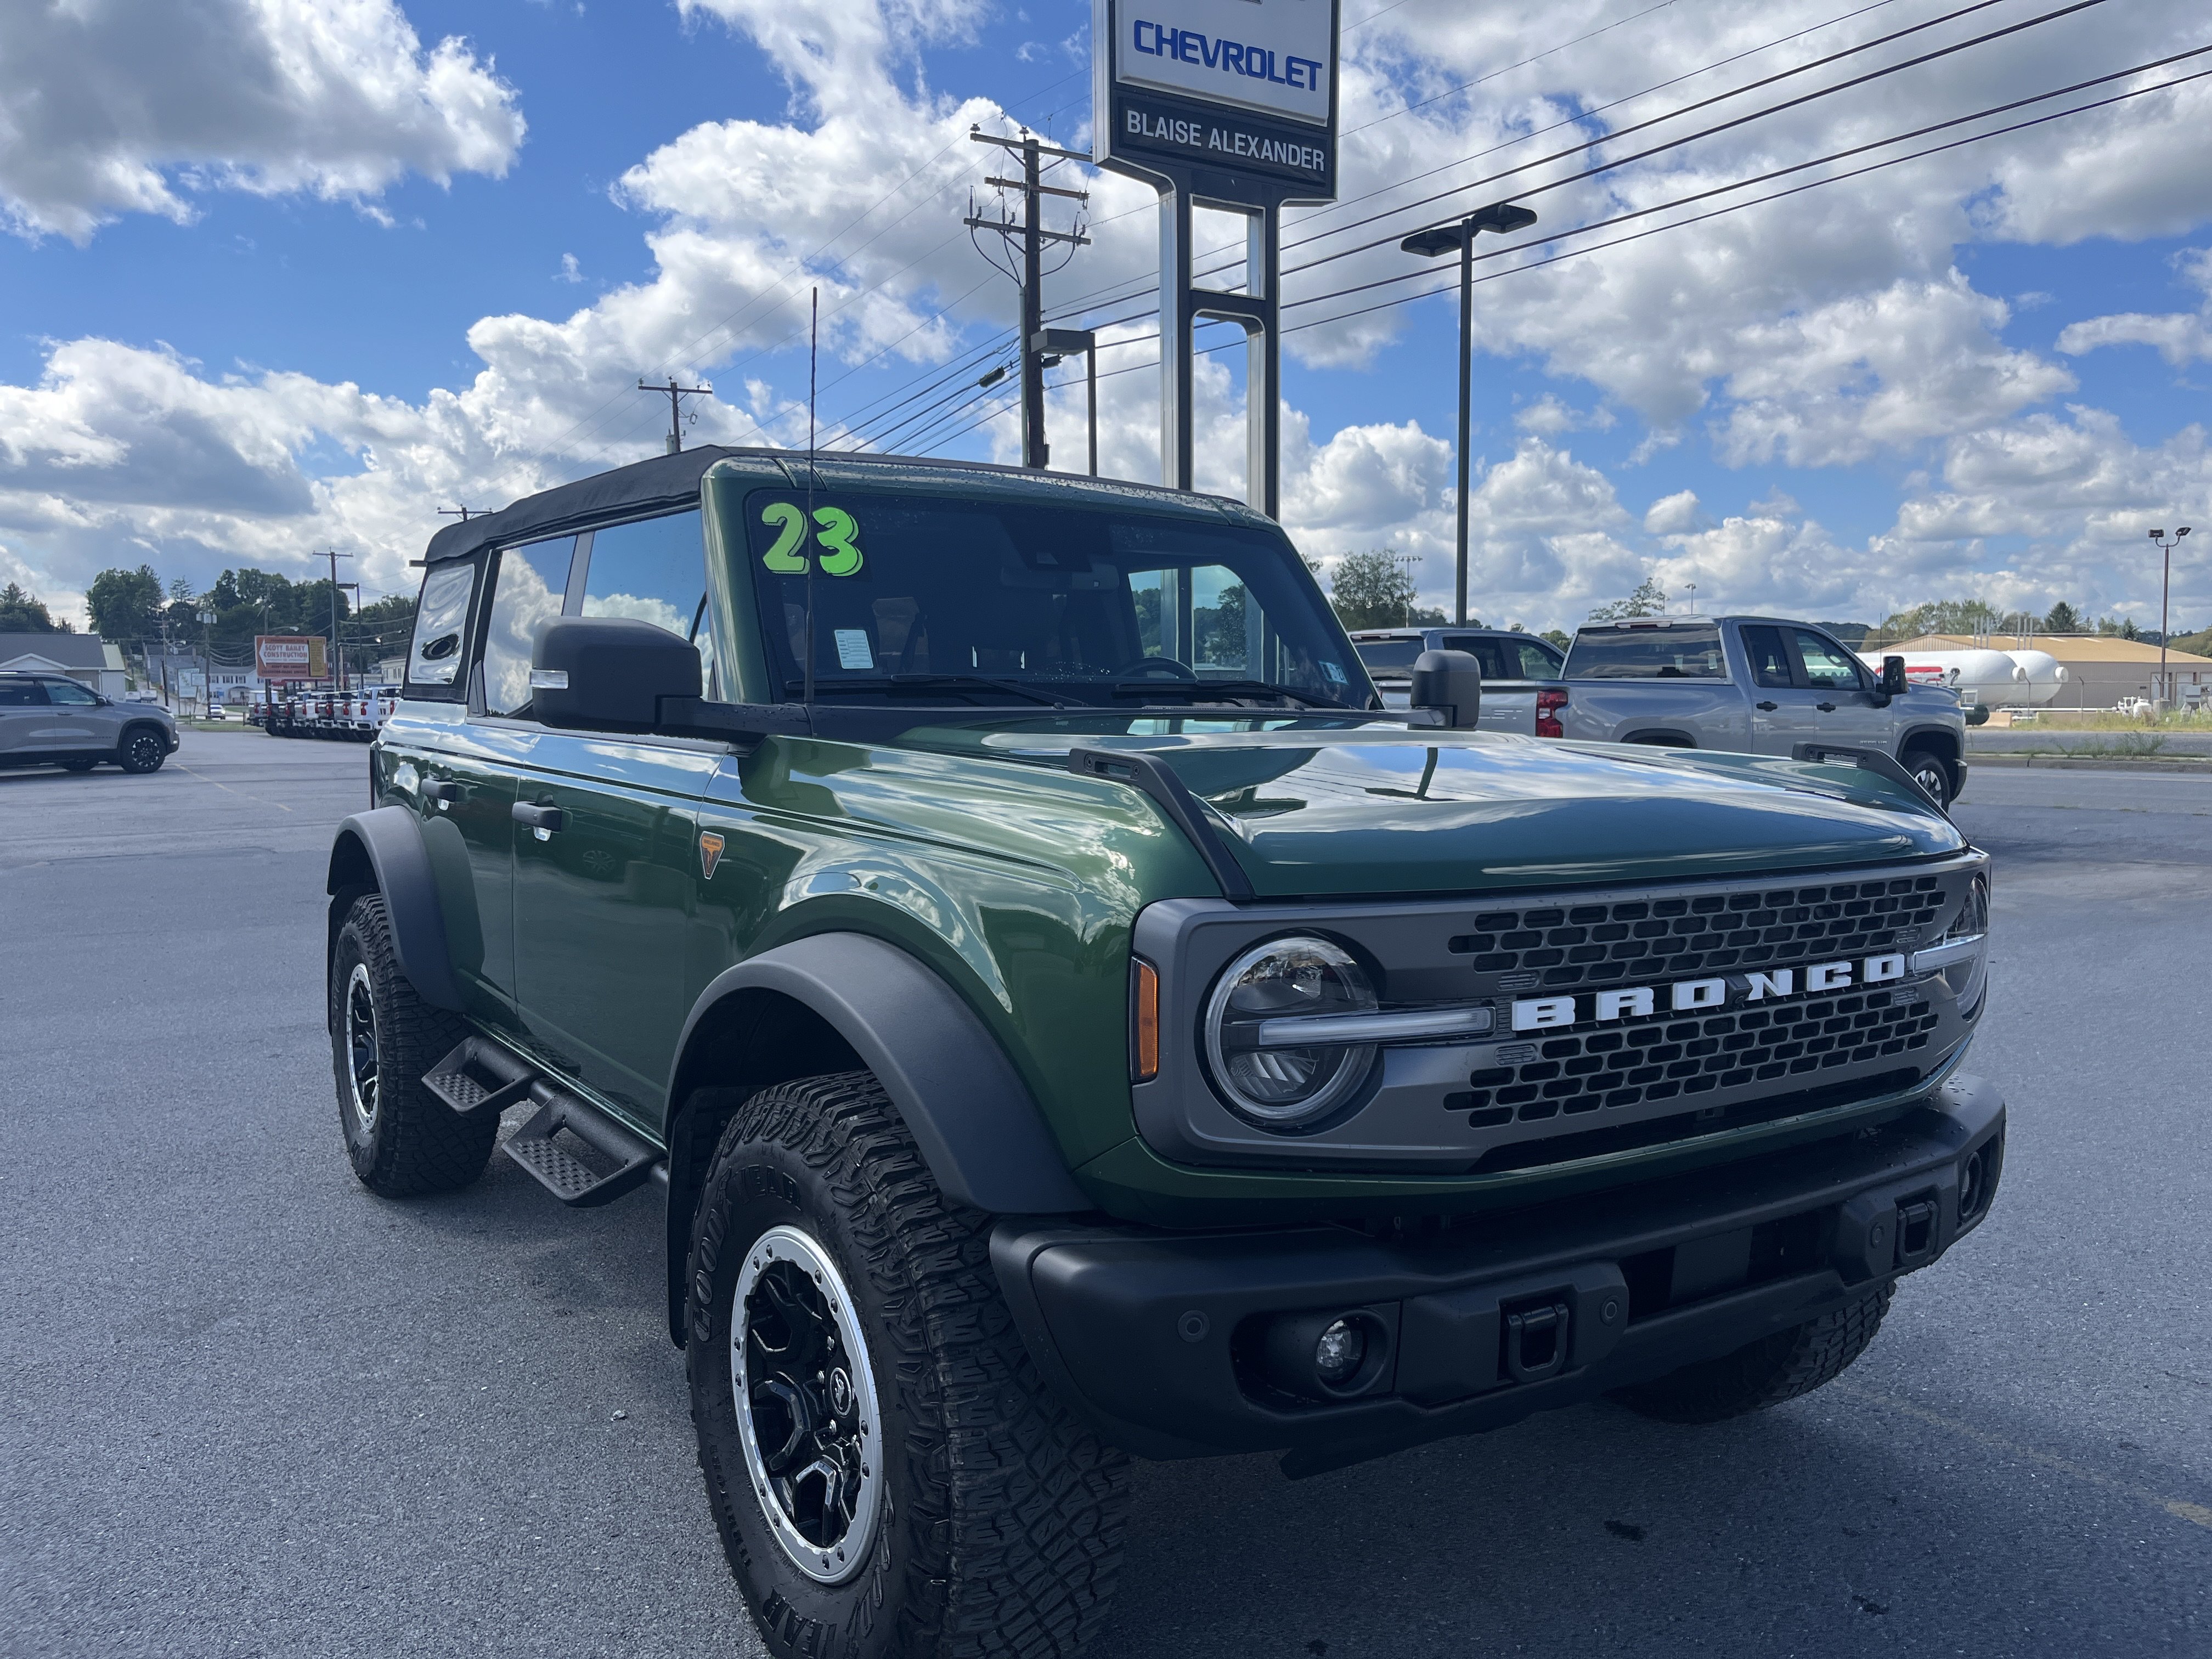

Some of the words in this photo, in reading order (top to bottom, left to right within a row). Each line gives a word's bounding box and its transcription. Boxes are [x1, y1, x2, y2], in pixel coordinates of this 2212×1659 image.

[1134, 20, 1323, 91] CHEVROLET
[1127, 110, 1202, 146] BLAISE
[1209, 128, 1325, 172] ALEXANDER
[761, 503, 864, 576] 23
[1512, 953, 1905, 1031] BRONCO
